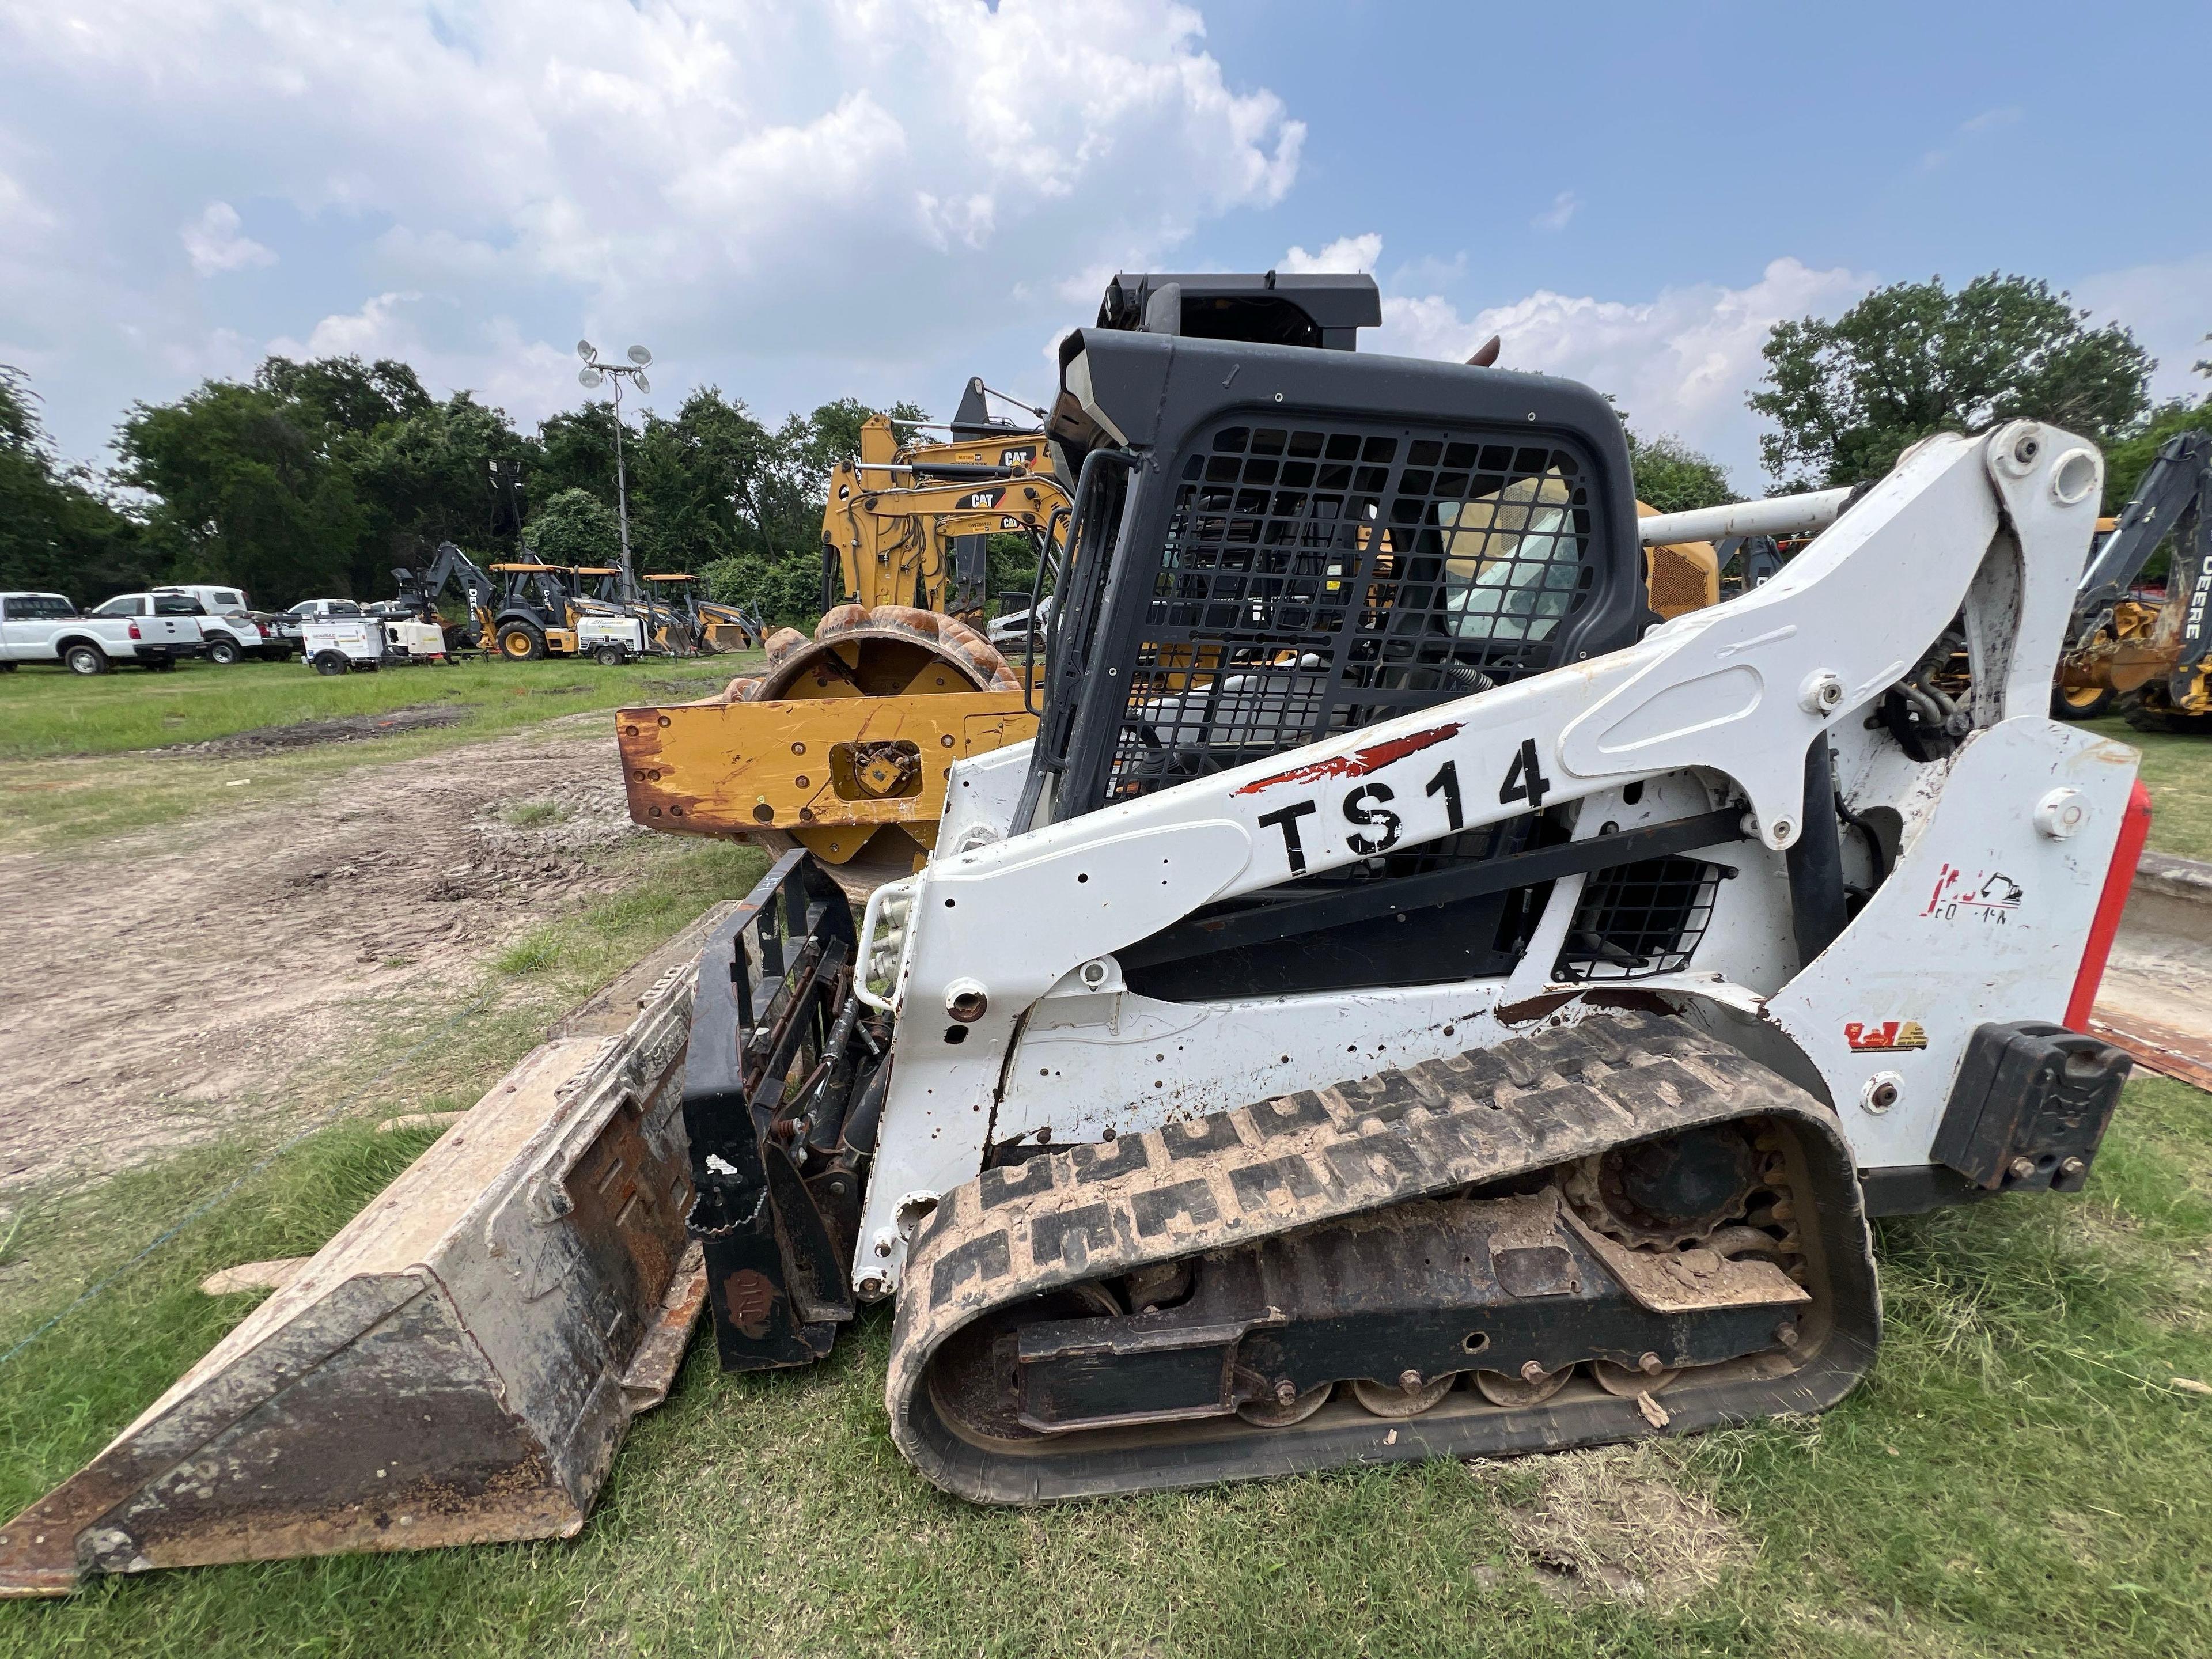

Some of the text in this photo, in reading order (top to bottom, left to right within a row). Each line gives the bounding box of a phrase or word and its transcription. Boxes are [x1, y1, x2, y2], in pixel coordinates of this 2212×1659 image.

[1005, 452, 1027, 467] CAT
[972, 494, 993, 508] CAT
[1257, 738, 1550, 877] TS14
